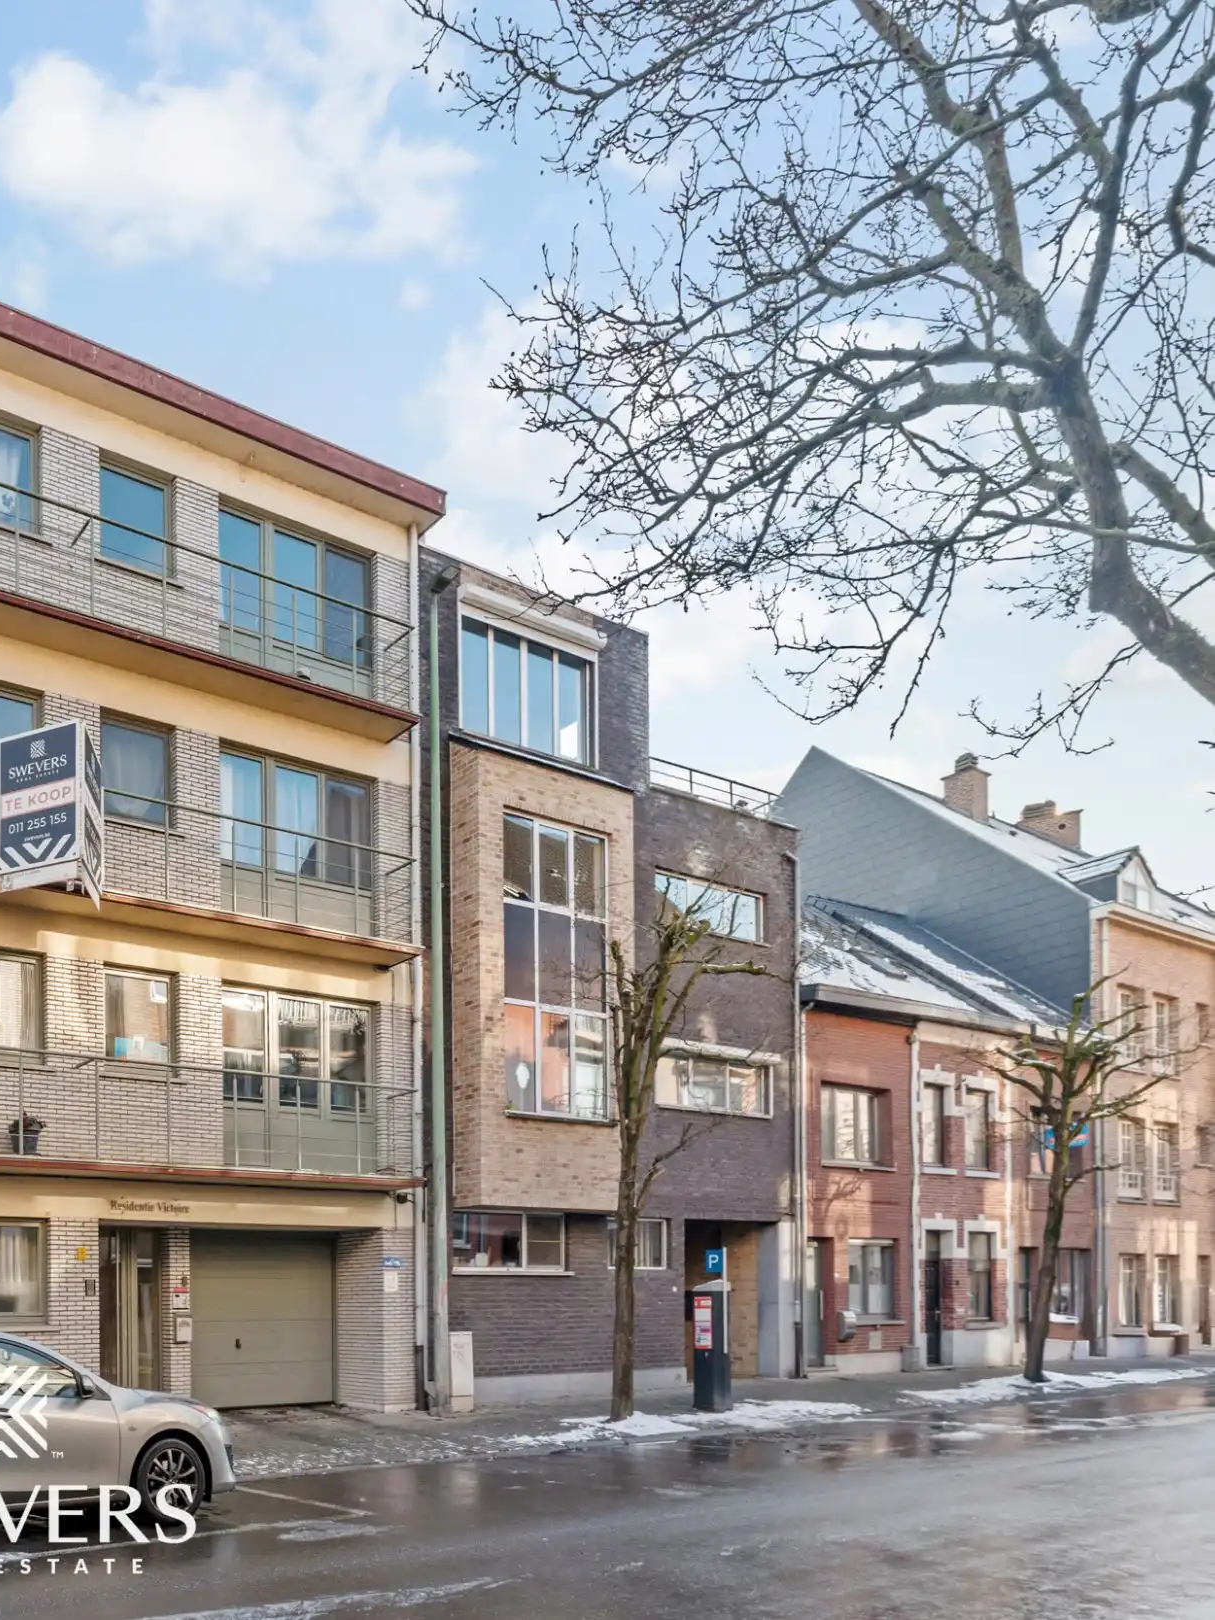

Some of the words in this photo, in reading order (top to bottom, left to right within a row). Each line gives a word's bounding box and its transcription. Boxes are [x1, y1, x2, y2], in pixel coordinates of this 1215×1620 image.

[8, 754, 67, 779] SWEVERS
[5, 798, 22, 811] TE
[28, 786, 71, 806] KOOP
[8, 822, 24, 834] 011
[27, 817, 46, 830] 255
[49, 812, 67, 824] 155
[110, 1199, 155, 1213] Residentie
[708, 1254, 719, 1268] P
